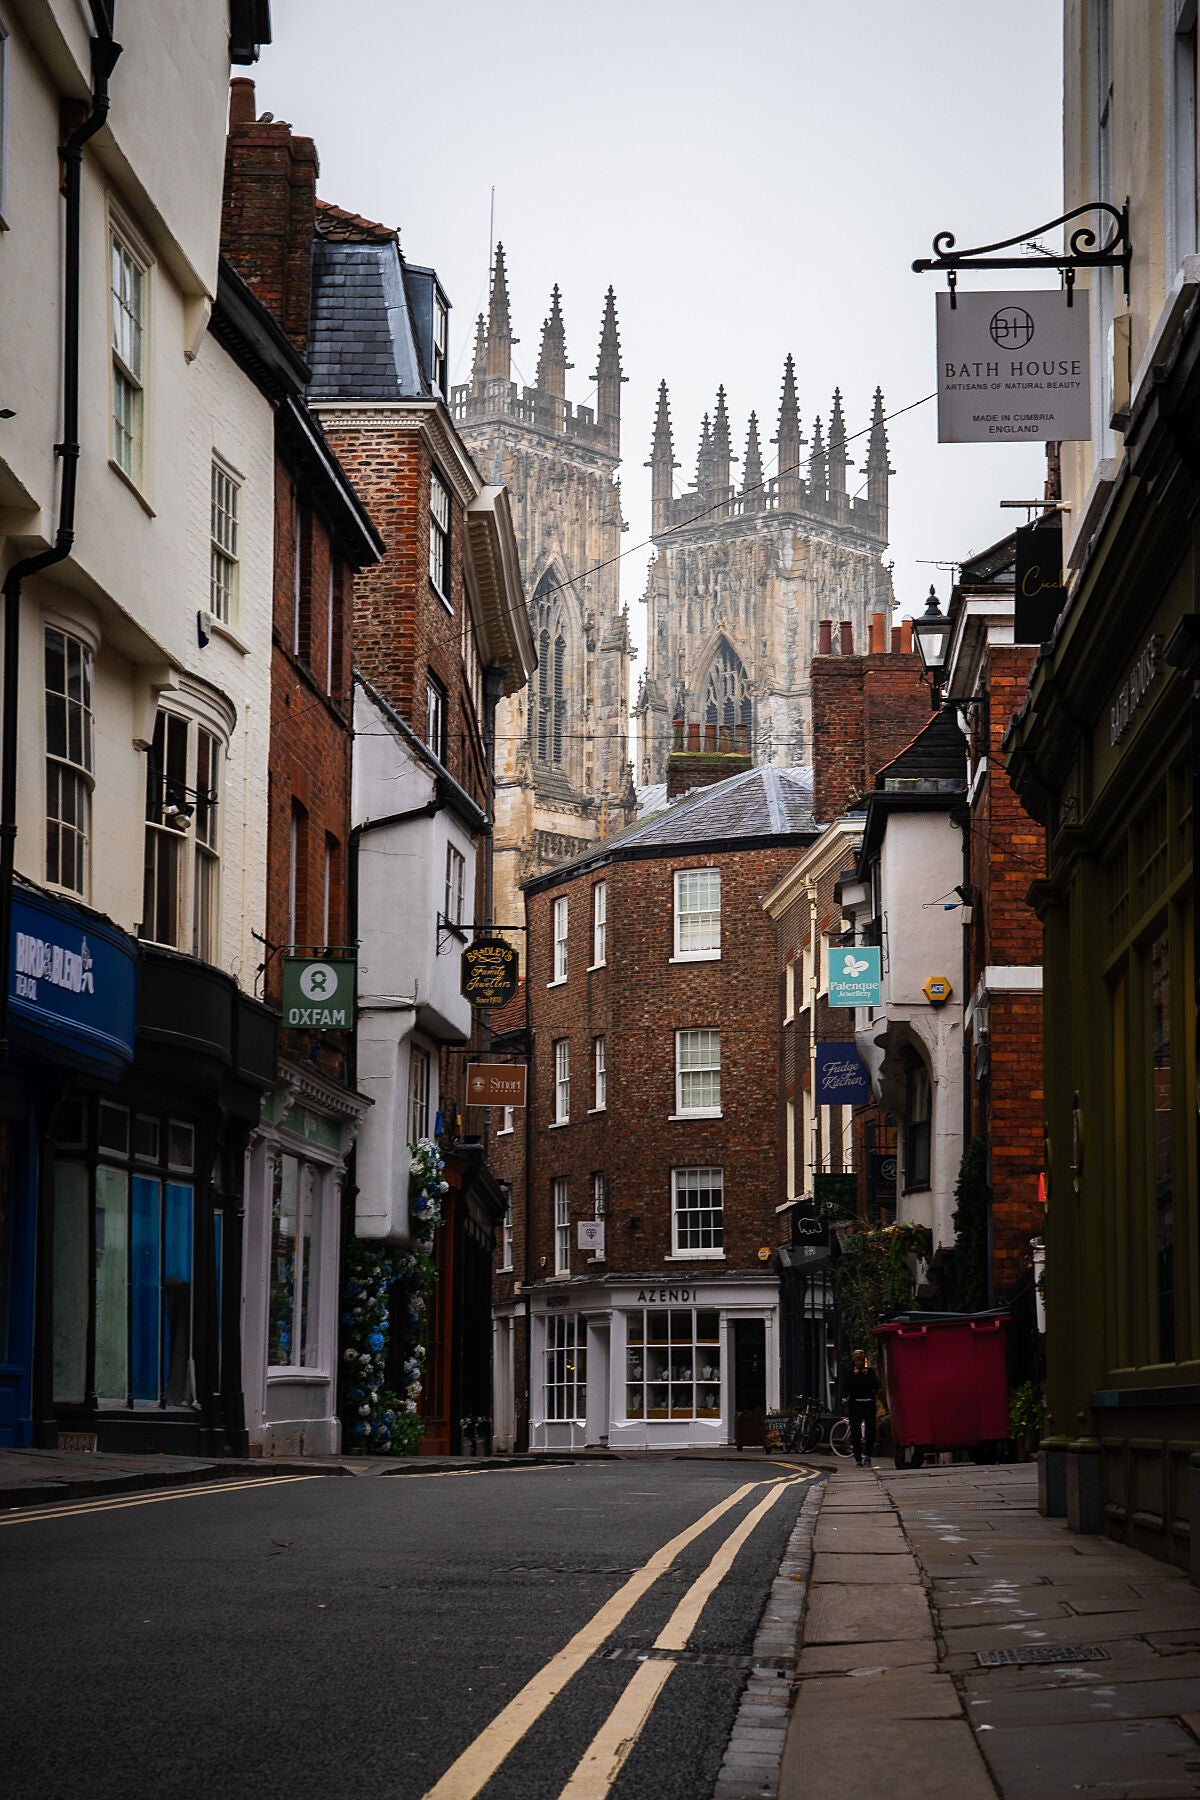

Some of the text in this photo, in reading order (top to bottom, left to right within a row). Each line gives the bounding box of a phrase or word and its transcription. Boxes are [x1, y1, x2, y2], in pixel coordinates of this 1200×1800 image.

[945, 360, 1082, 378] BATH HOUSE
[944, 381, 1082, 391] ARTISANS OF NATURAL BEAUTY
[972, 413, 1055, 422] MADE IN CUMBRIA
[988, 424, 1040, 434] ENGLAND
[466, 946, 513, 963] BRADLEYS
[470, 964, 506, 977] Family
[466, 976, 511, 991] Jewellers
[830, 981, 880, 992] Palenque
[837, 990, 871, 998] Jewellery
[288, 1008, 346, 1026] OXFAM
[822, 1060, 859, 1077] Fudge
[489, 1077, 522, 1090] Smart
[822, 1075, 866, 1090] Kitchen
[637, 1289, 697, 1303] AZENDI
